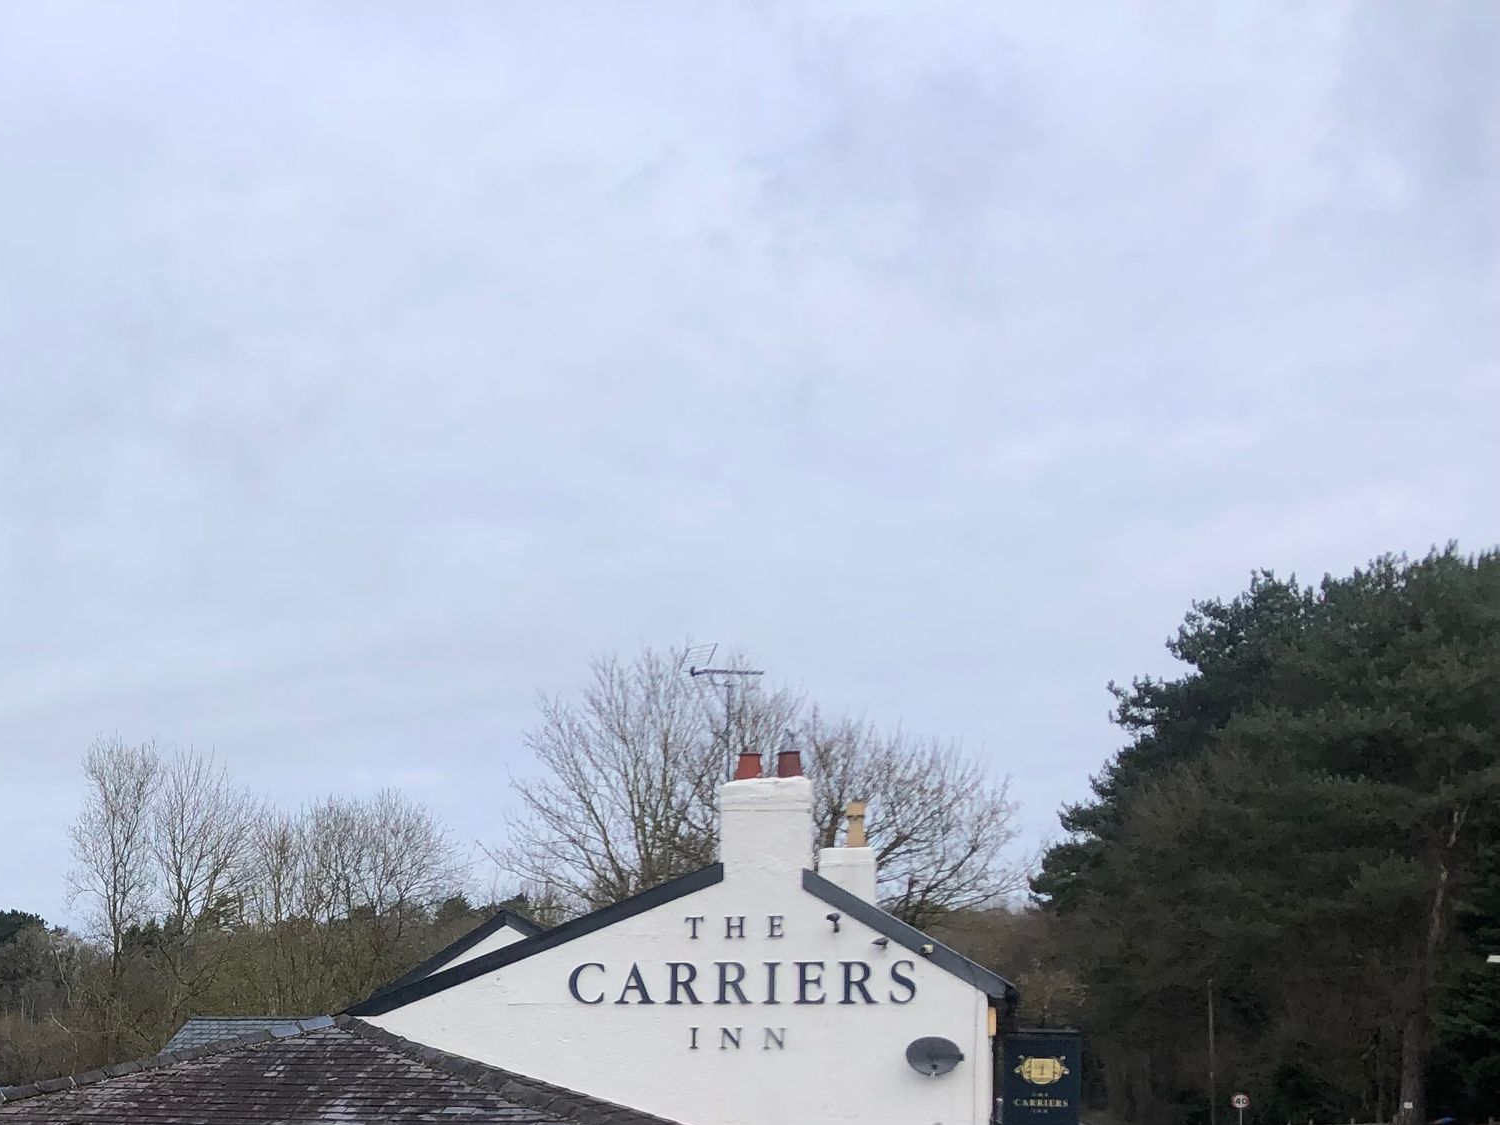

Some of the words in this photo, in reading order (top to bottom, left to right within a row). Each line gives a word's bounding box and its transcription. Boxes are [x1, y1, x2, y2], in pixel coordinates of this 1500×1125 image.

[685, 914, 785, 940] THE
[568, 959, 918, 1006] CARRIERS
[689, 1026, 788, 1051] INN
[1013, 1098, 1069, 1107] CARRIERS
[1234, 1097, 1248, 1105] 40
